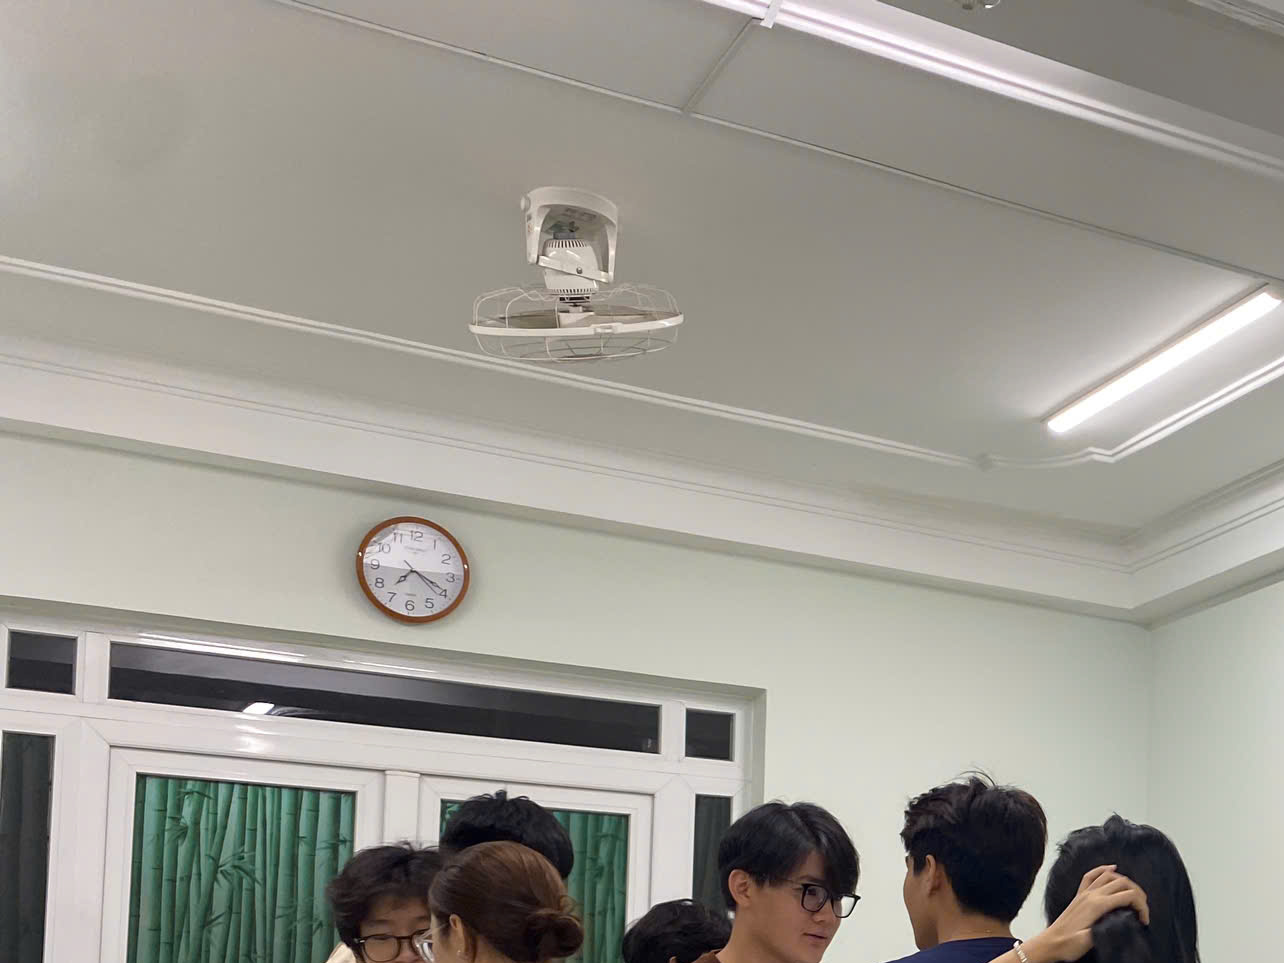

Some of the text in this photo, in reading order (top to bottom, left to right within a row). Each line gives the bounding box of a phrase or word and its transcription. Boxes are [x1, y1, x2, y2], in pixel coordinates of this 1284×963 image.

[410, 531, 423, 542] 12
[378, 543, 391, 553] 10
[370, 559, 380, 569] 9
[441, 554, 451, 565] 2
[375, 577, 384, 588] 8
[446, 572, 455, 583] 3
[388, 592, 397, 602] 7
[405, 600, 415, 611] 6
[425, 598, 434, 608] 5
